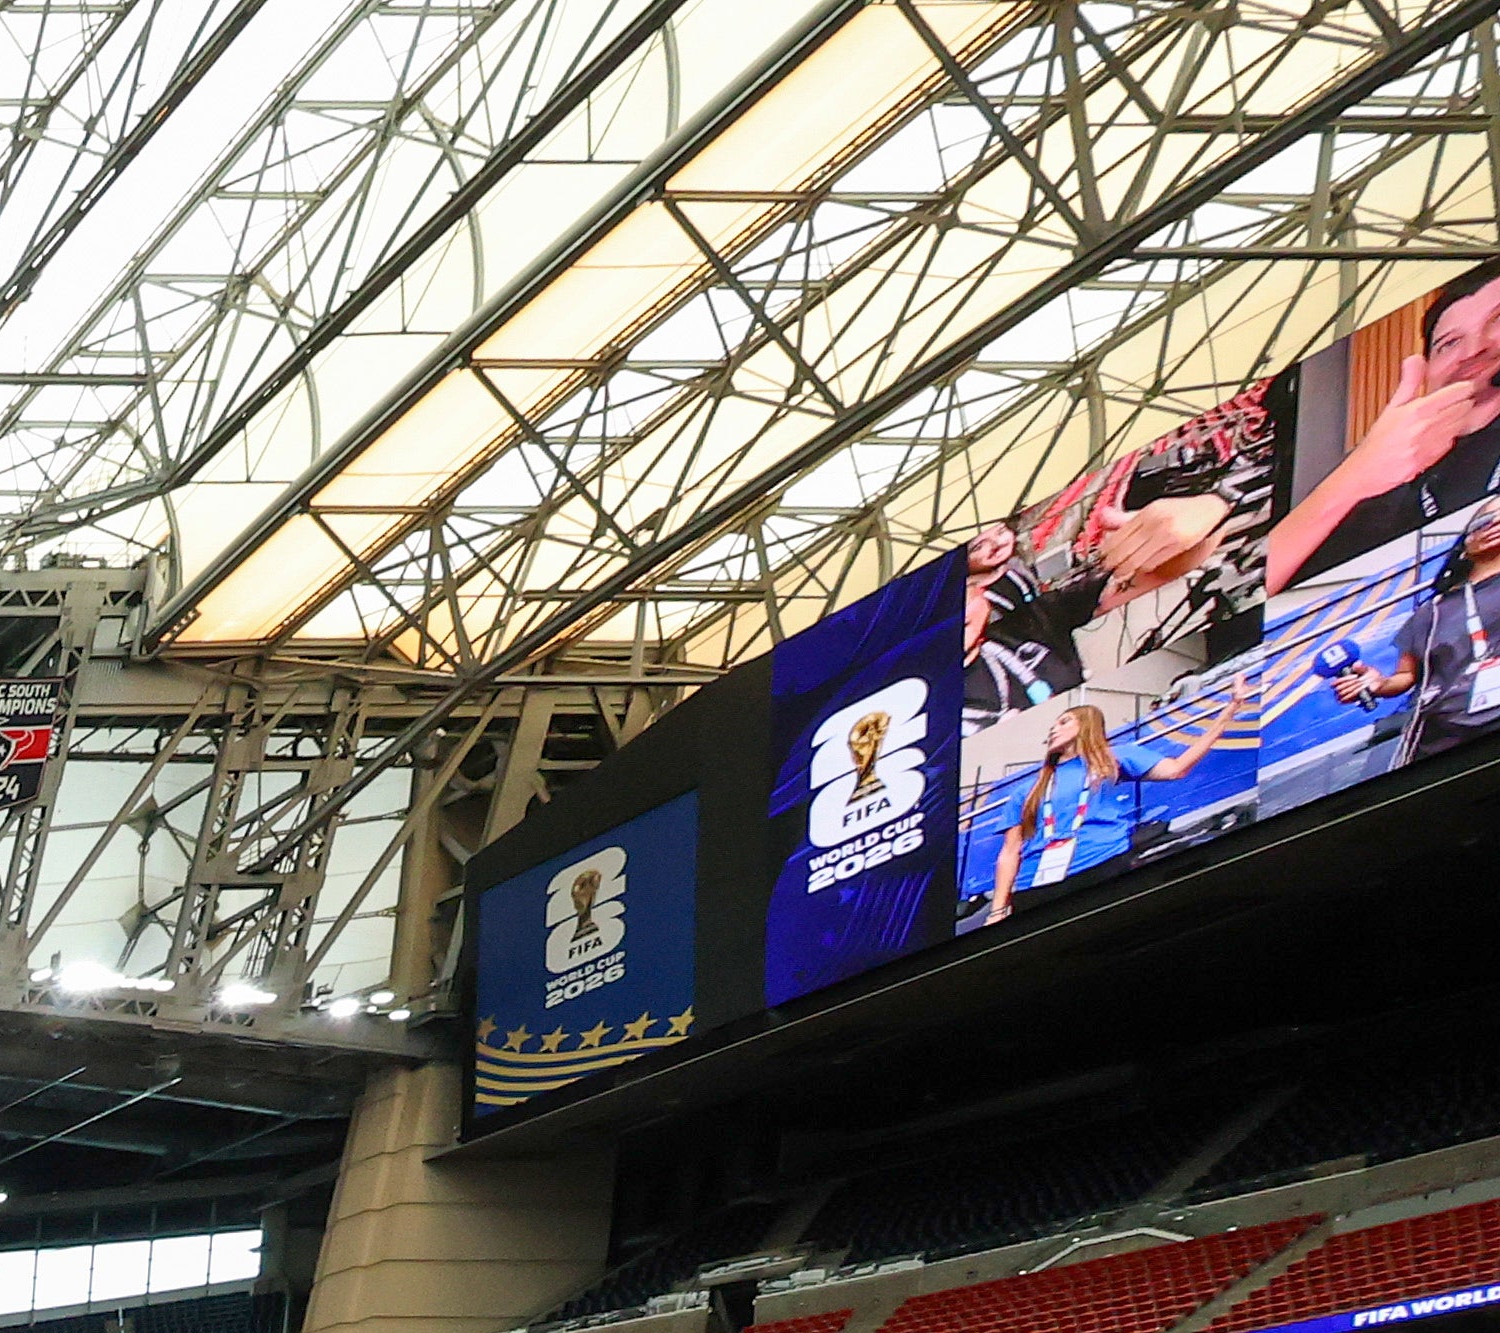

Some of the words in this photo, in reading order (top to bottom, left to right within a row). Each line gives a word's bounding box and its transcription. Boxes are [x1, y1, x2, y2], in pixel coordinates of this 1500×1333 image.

[8, 684, 51, 698] SOUTH
[842, 797, 891, 828] FIFA
[809, 831, 880, 870] WORLD
[881, 812, 924, 840] CUP
[808, 829, 924, 894] 2026
[568, 937, 602, 959] FIFA
[545, 963, 626, 1009] 2026
[546, 964, 595, 991] WORLD
[597, 951, 626, 970] CUP
[1352, 1305, 1408, 1327] FIFA
